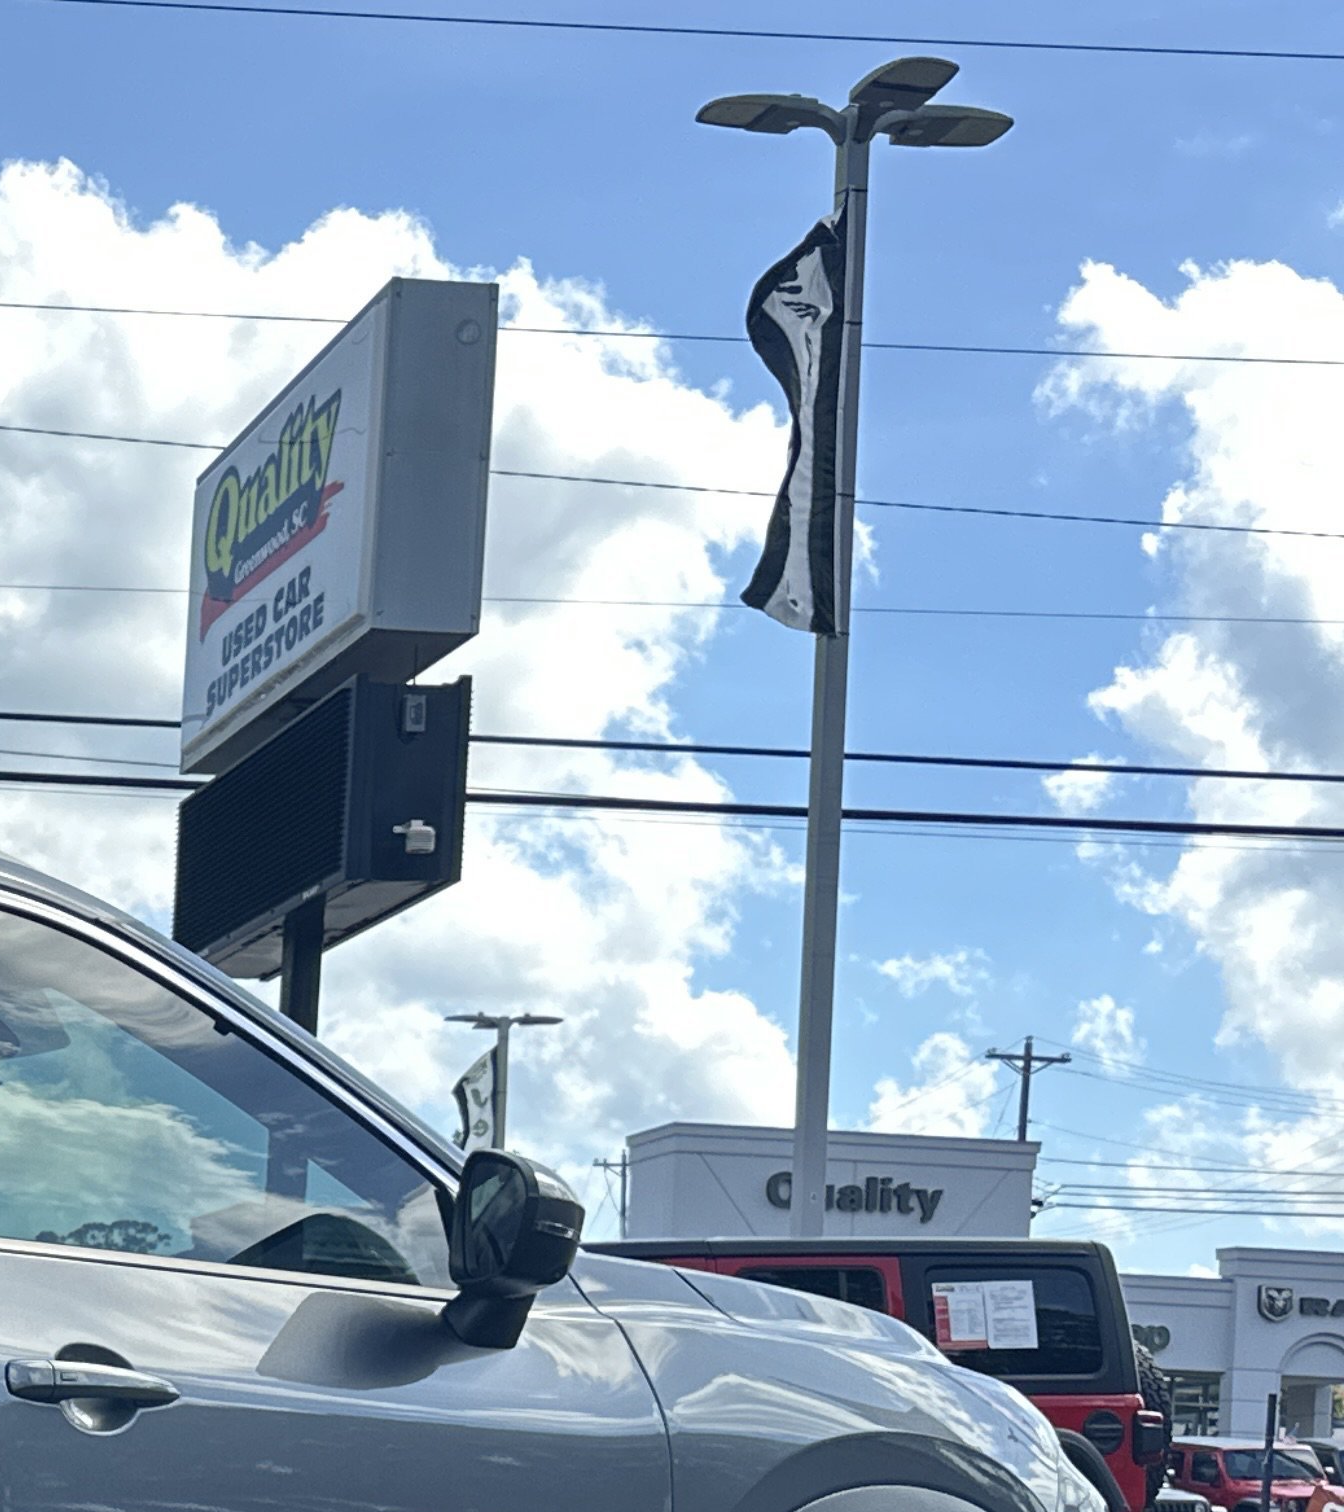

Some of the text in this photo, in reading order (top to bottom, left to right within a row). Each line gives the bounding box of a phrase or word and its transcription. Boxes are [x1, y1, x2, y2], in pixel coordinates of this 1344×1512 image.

[206, 392, 341, 578] Quality
[206, 591, 325, 717] SUPERSTORE
[222, 565, 311, 667] USED CAR
[766, 1171, 944, 1224] Qality
